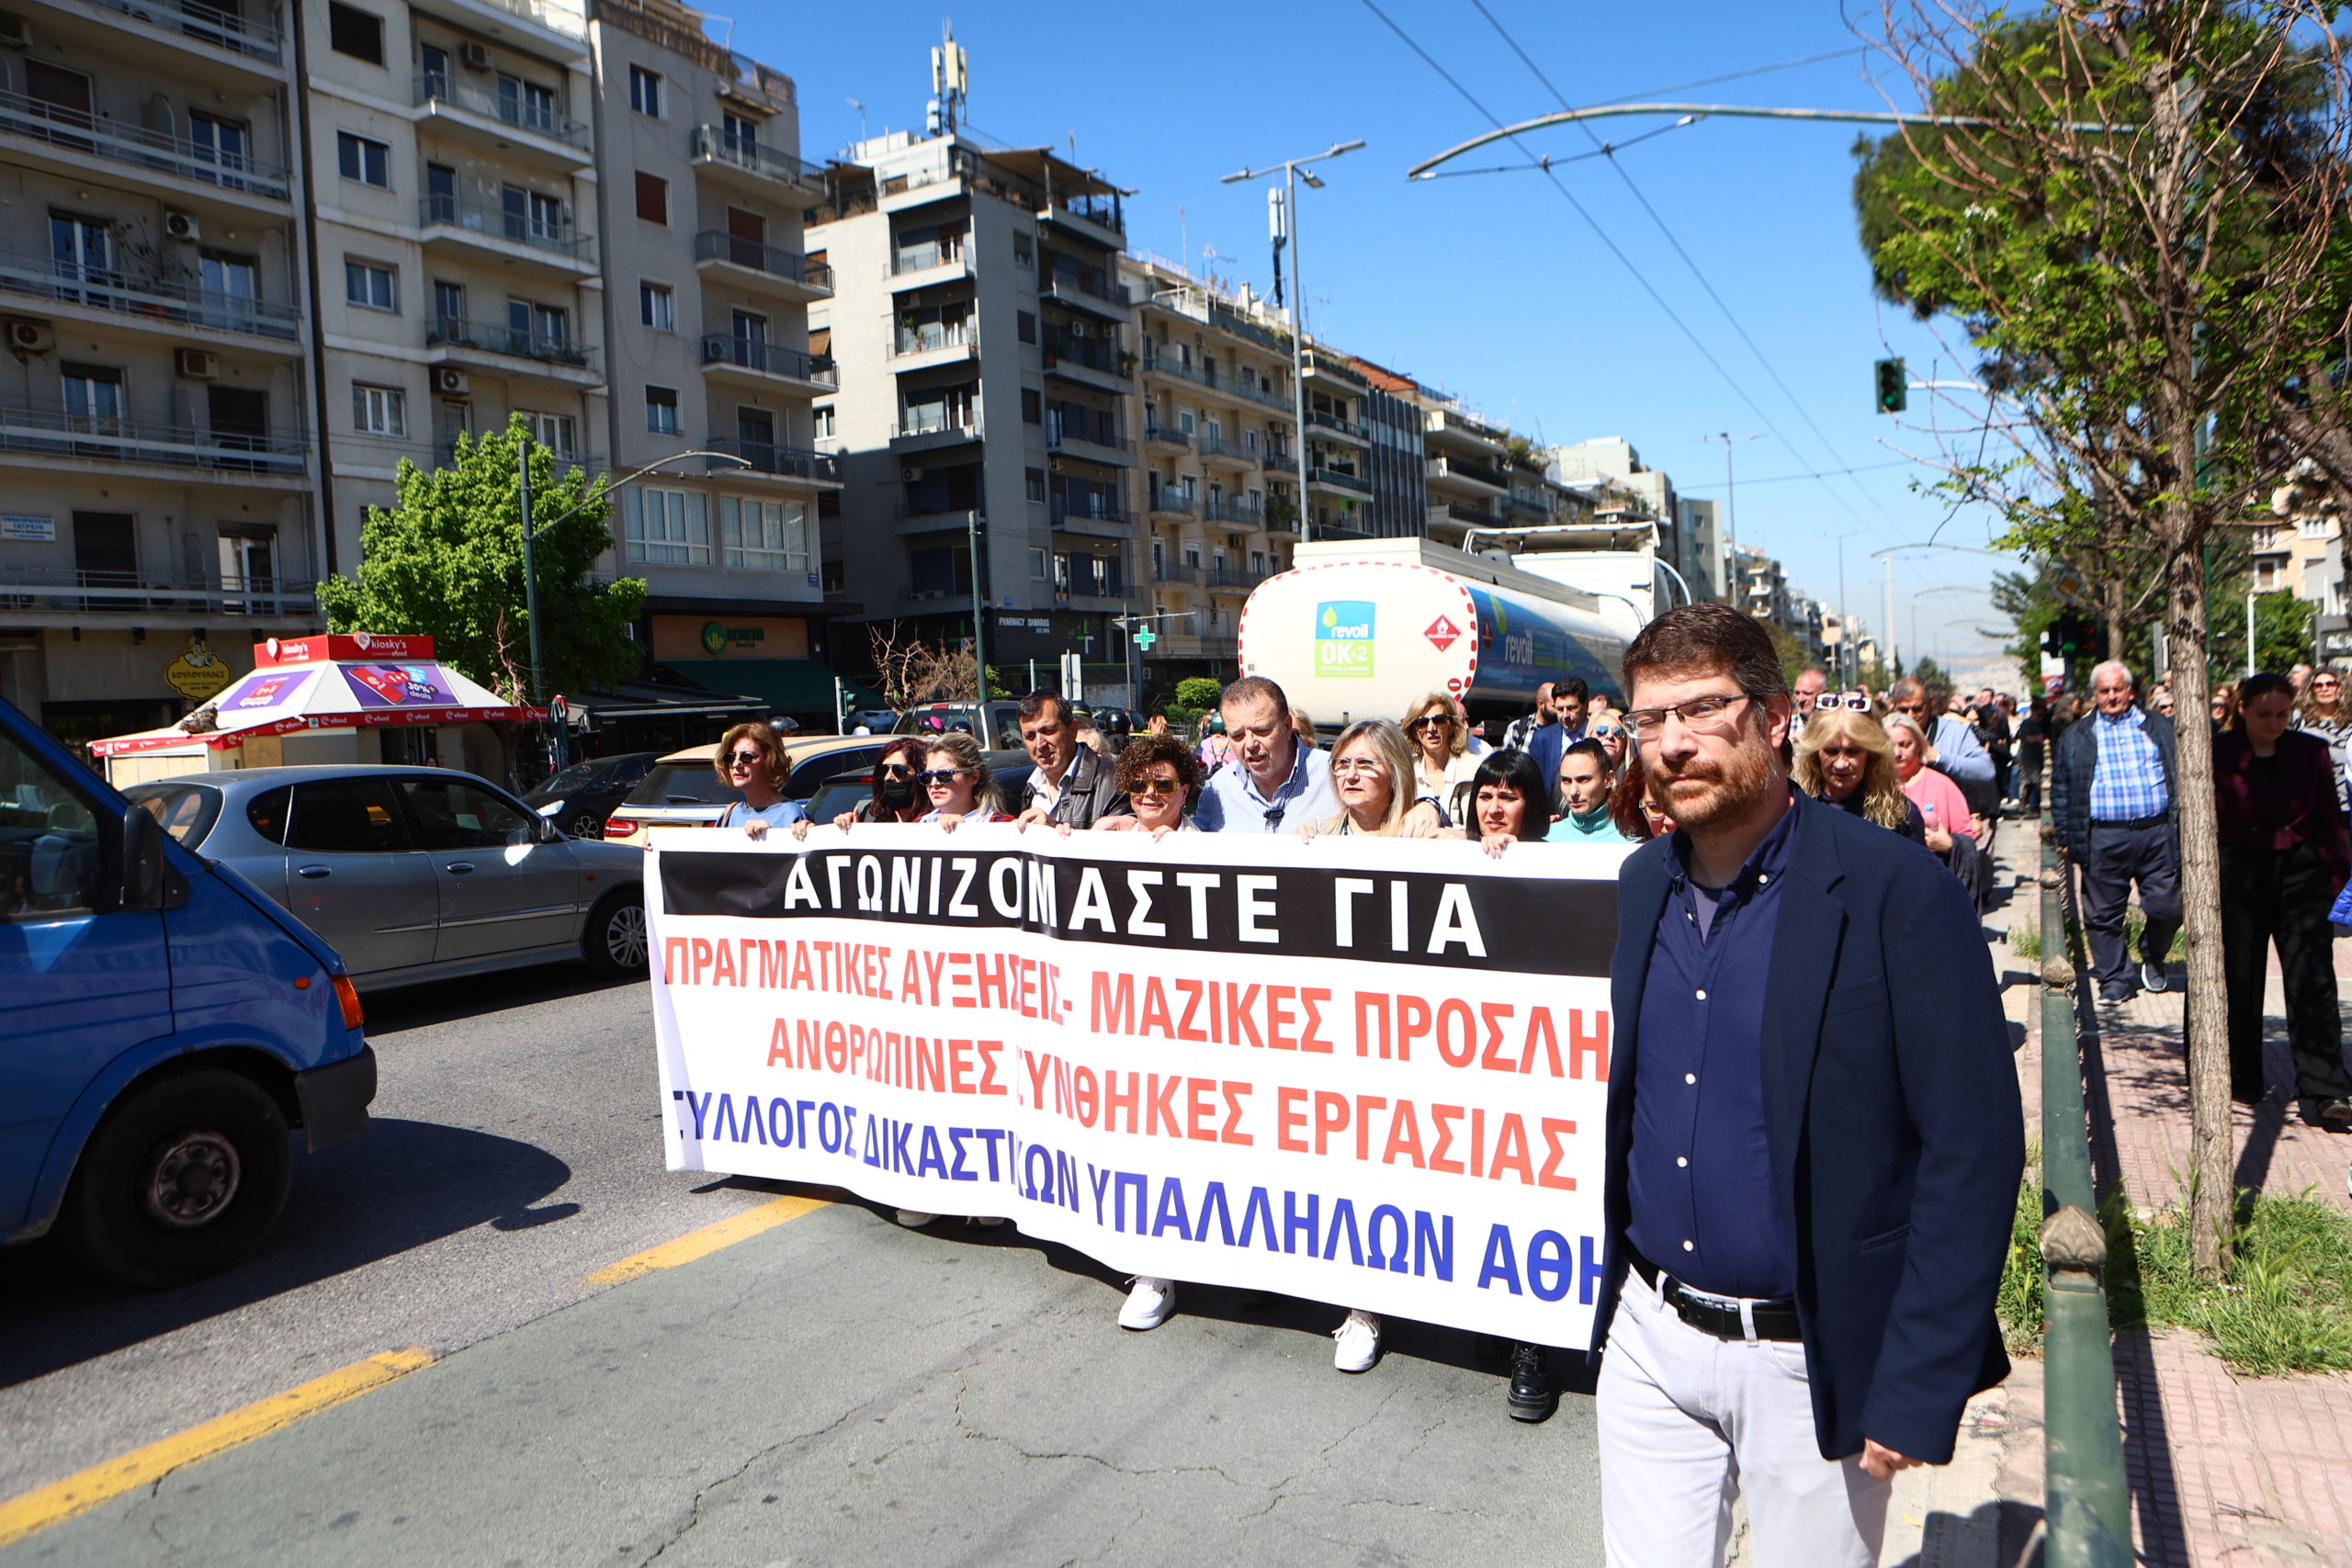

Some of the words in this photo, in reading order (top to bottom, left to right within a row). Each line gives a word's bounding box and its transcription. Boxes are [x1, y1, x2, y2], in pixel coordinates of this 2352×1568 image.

[371, 638, 407, 649] kiosky's
[999, 617, 1024, 626] PHARMACY
[1330, 623, 1369, 638] revoil
[1505, 629, 1532, 665] revoil
[785, 854, 1279, 943] ΑΓΩΝΙΖΟΜΑΣΤΕ
[1335, 877, 1487, 958] ΓΙΑ
[664, 936, 893, 1001] ΠΡΑΓΜΑΤΙΚΕΣ
[1091, 971, 1334, 1055] ΜΑΖΙΚΕΣ
[1354, 990, 1610, 1083] ΠΡΟΣΛΗ
[766, 1017, 1007, 1096] ΑΝΘΡΩΠΙΝΕΣ
[1277, 1087, 1577, 1192] ΕΡΓΑΣΙΑΣ
[1087, 1162, 1454, 1283] ΥΠΑΛΛΗΛΩΝ
